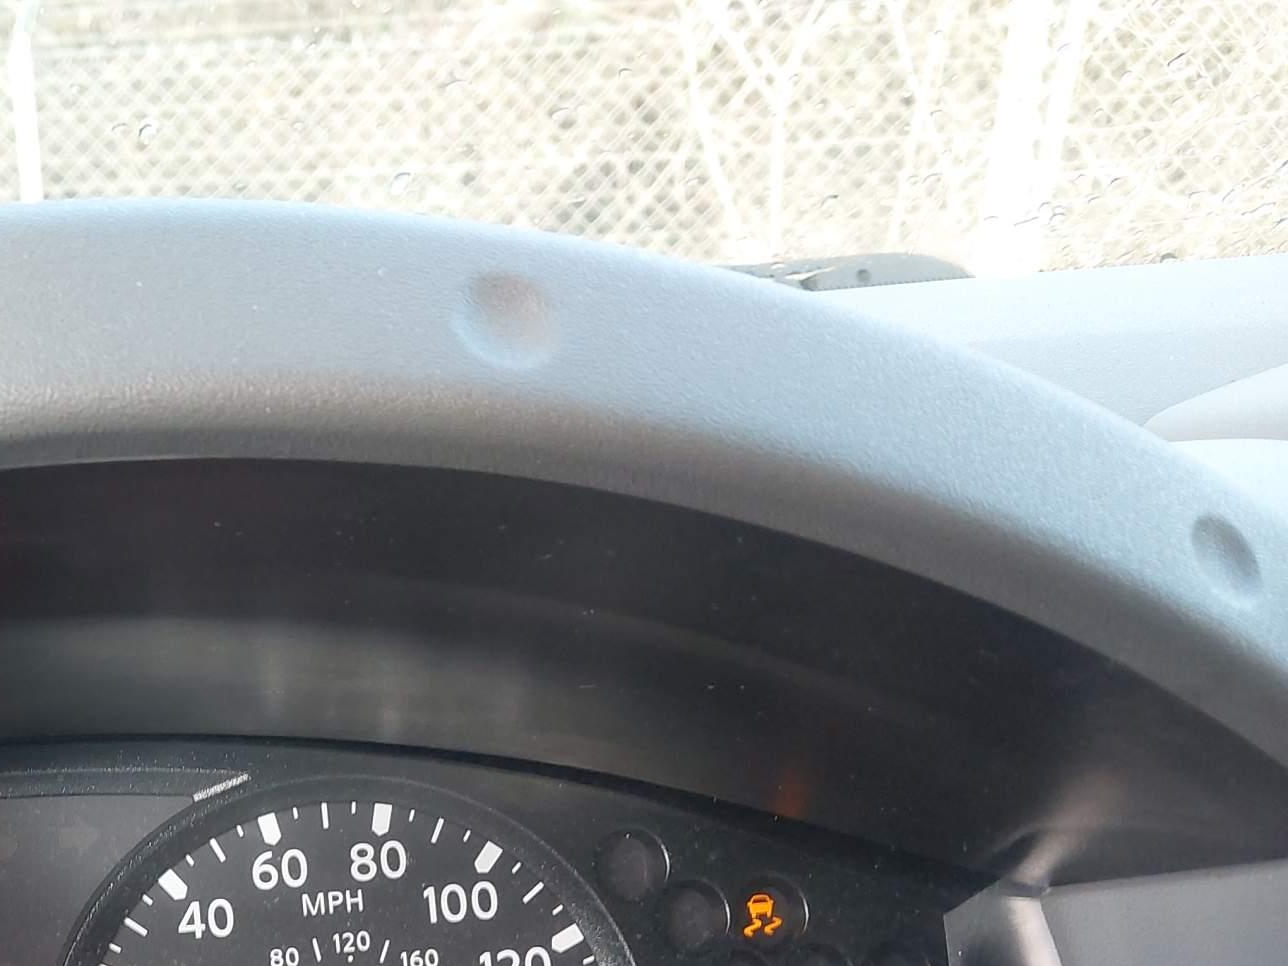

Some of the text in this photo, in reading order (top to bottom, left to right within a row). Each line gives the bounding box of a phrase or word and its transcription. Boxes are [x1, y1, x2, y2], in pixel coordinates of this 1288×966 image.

[251, 846, 308, 891] 60
[349, 839, 407, 881] 80
[178, 898, 234, 939] 40
[301, 889, 364, 918] MPH
[423, 880, 498, 924] 100
[332, 930, 371, 954] 120
